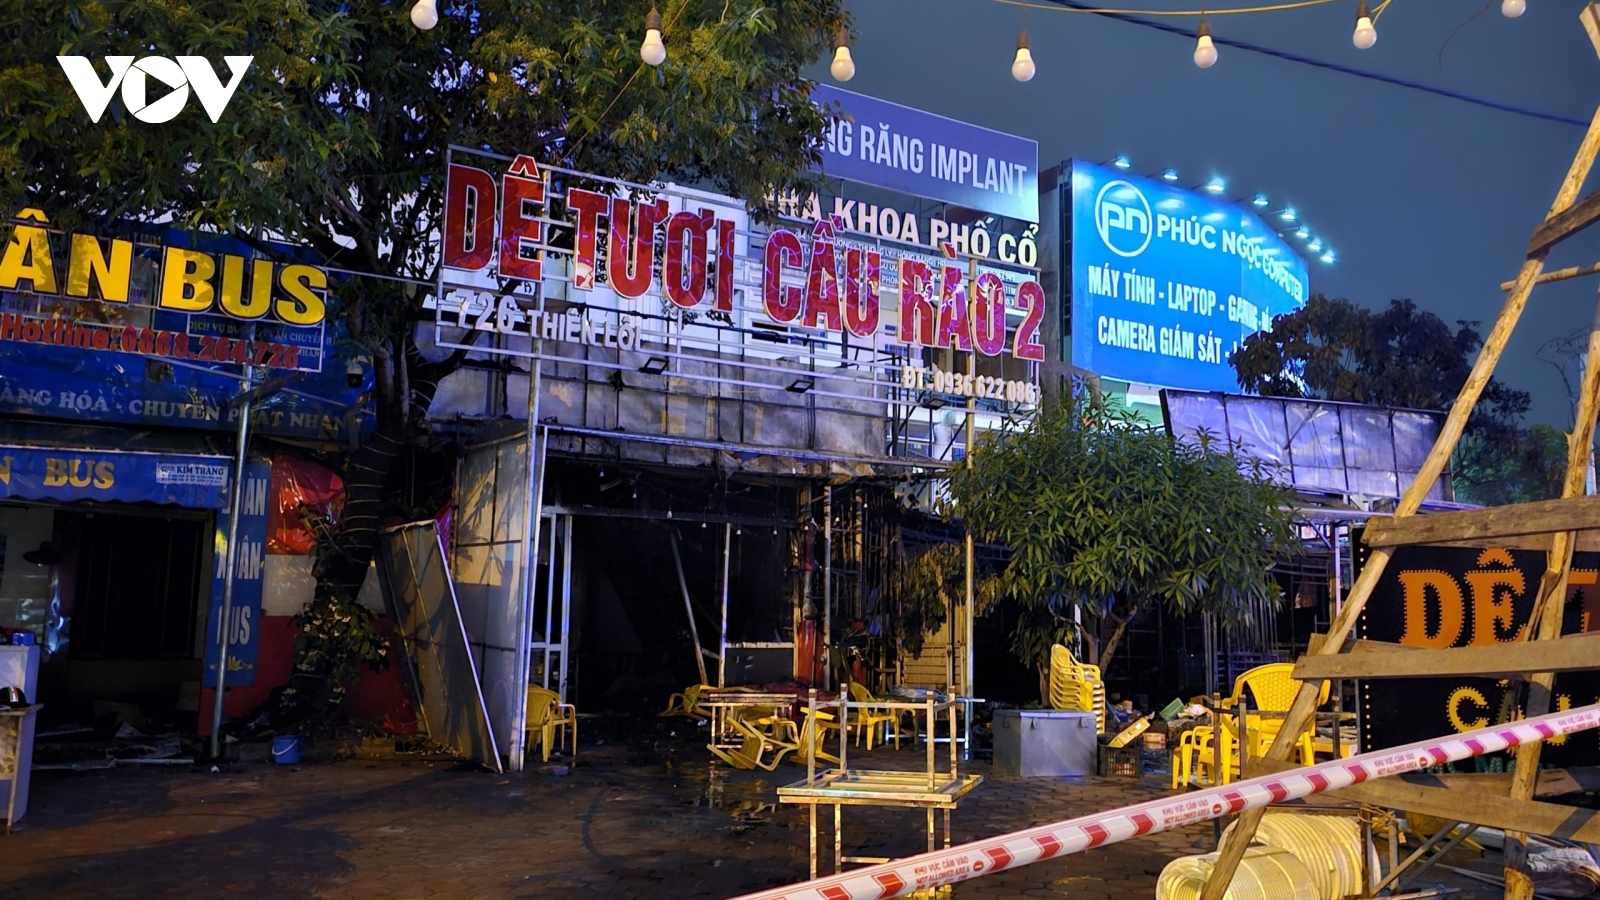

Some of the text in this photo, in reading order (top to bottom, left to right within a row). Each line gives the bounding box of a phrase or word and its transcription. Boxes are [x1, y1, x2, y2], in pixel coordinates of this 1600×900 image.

[809, 117, 1028, 198] NG RĂNG IMPLANT
[764, 184, 1040, 268] HA KHOA PHỐ CỔ
[1157, 216, 1217, 249] PHÚC
[1222, 229, 1262, 270] NGỌC
[443, 154, 1045, 362] DÊ TƯƠI CẦU RÀO 2
[159, 247, 327, 327] BUS
[1088, 263, 1120, 299] MÁY
[1123, 268, 1155, 305] TÍNH
[1167, 281, 1216, 317] LAPTOP
[455, 288, 515, 335] 726
[527, 308, 598, 346] THIÊN
[1098, 316, 1155, 353] CAMERA
[1159, 324, 1194, 360] GIÁM
[1198, 330, 1222, 365] SÁT
[934, 370, 973, 396] 0936
[974, 375, 1005, 400] 622
[43, 458, 115, 490] BUS
[177, 465, 193, 475] KIM
